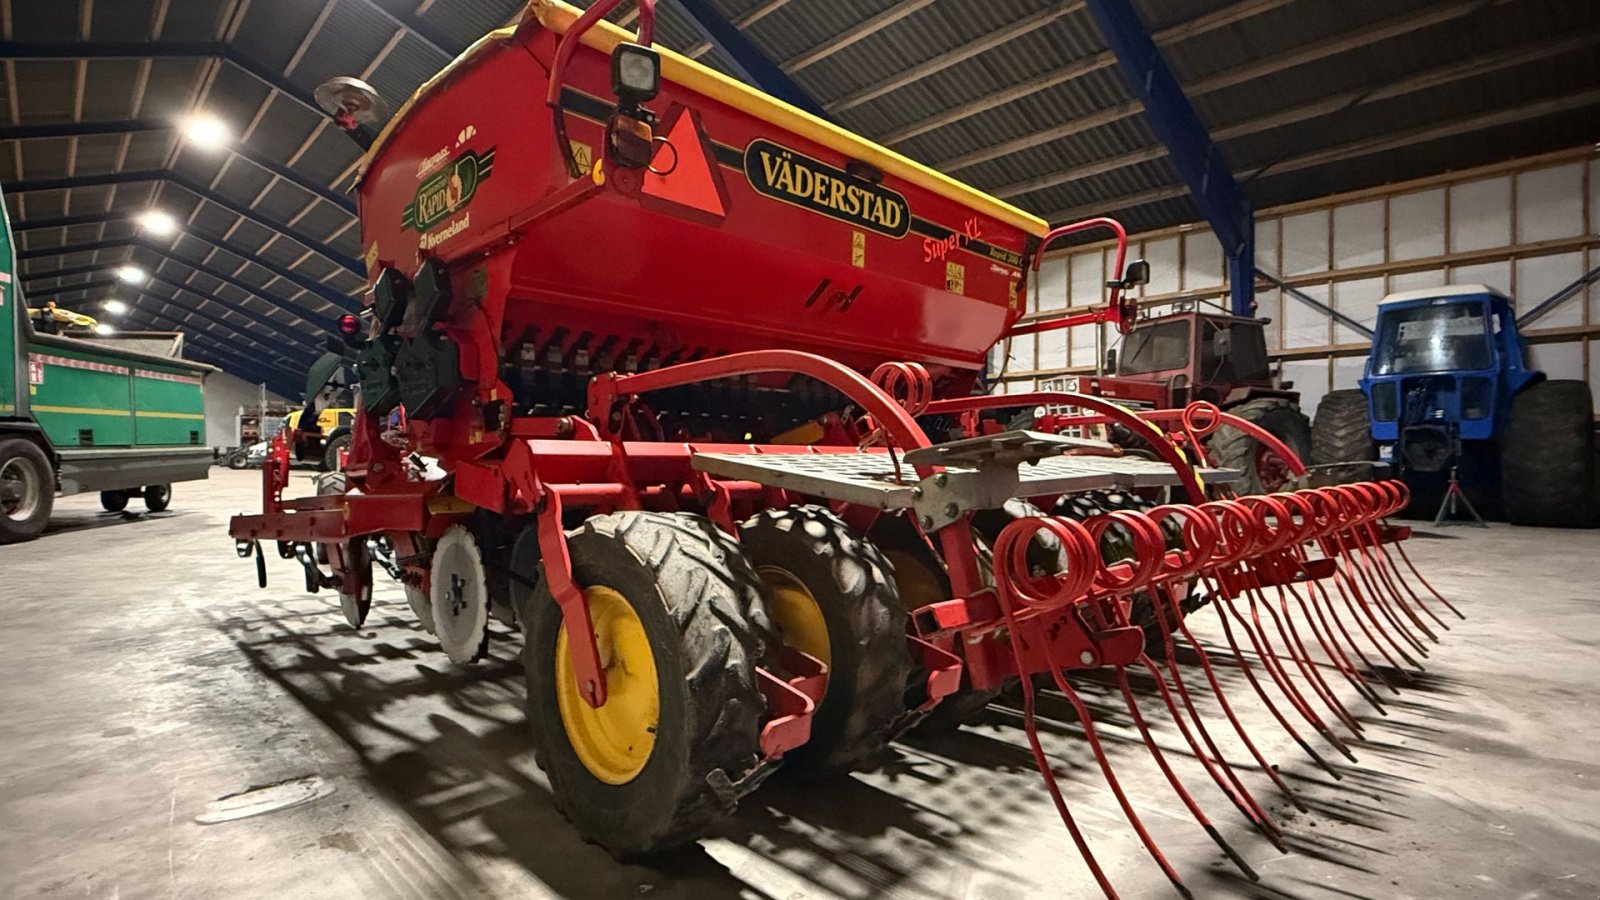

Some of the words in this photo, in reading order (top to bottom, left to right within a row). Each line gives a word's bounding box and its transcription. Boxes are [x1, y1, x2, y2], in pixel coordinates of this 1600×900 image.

[419, 189, 446, 224] RAPID
[760, 151, 901, 229] VÄDERSTAD
[427, 211, 470, 250] Kverneland
[923, 231, 961, 263] Super
[964, 217, 982, 247] XL
